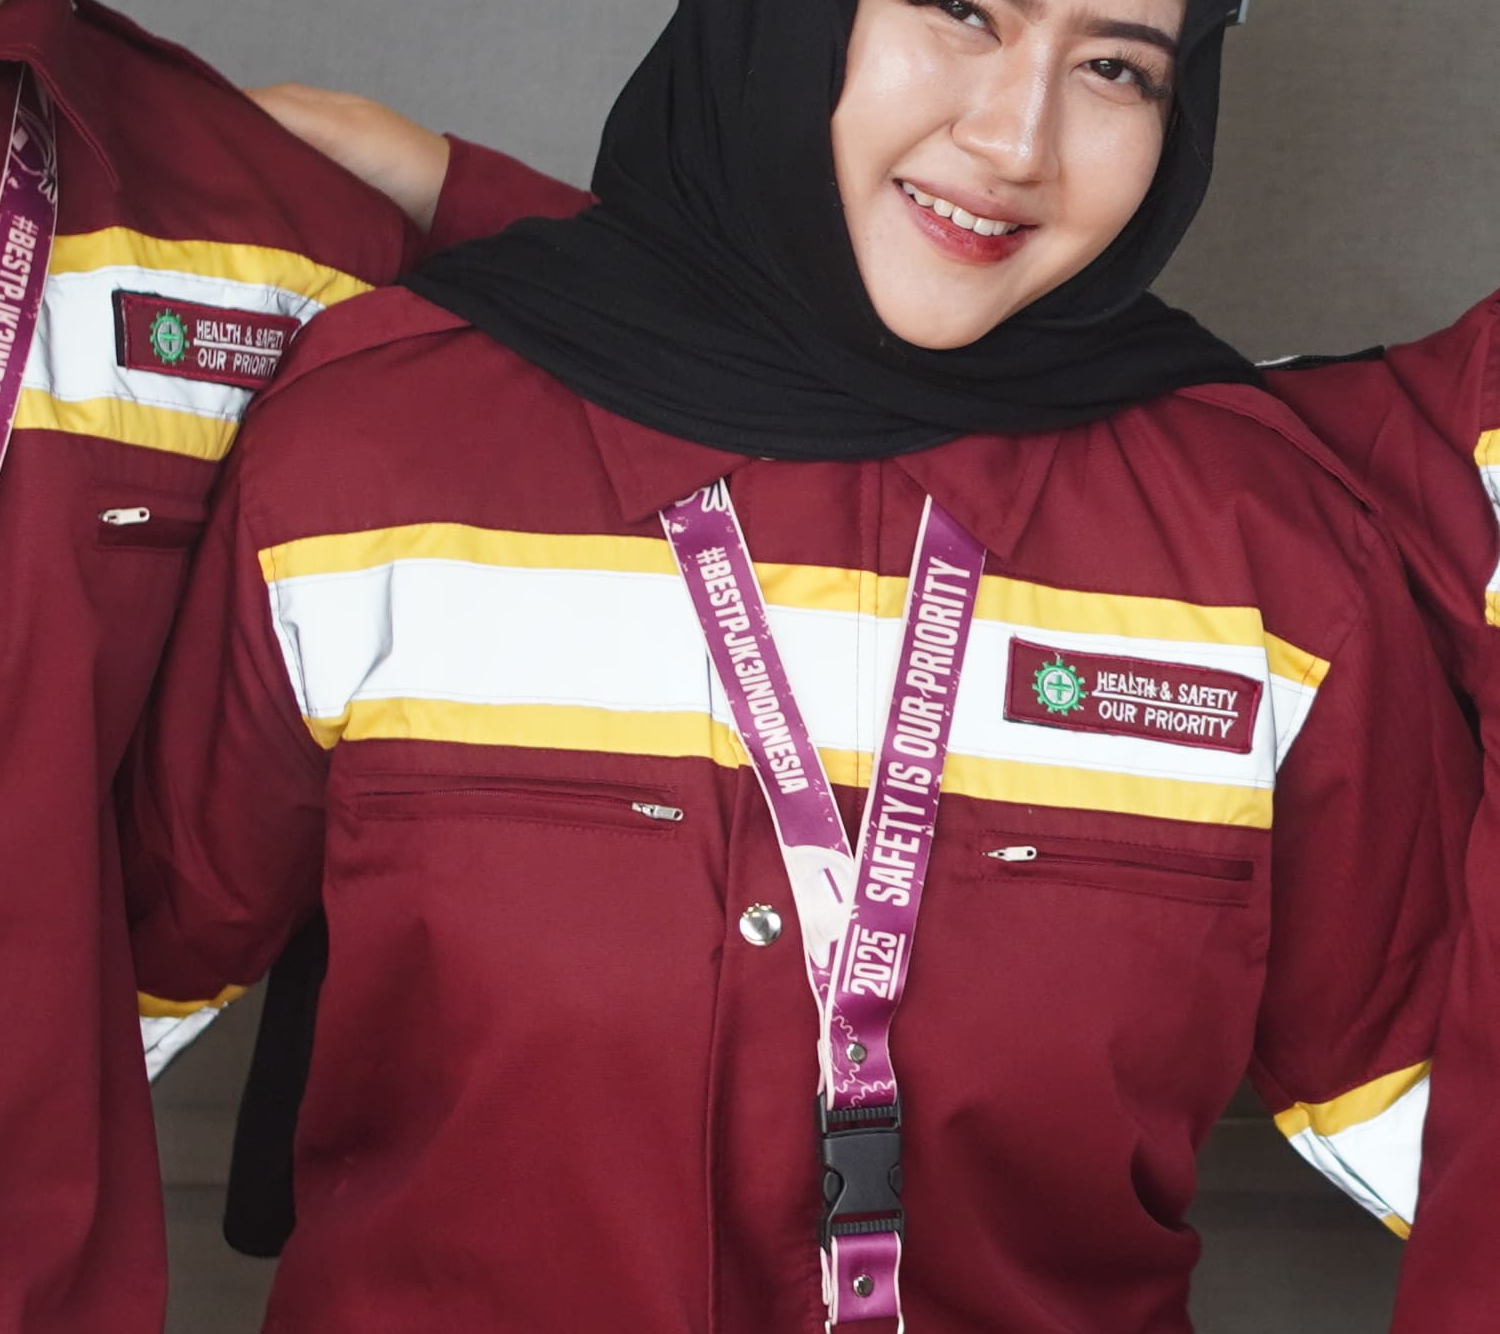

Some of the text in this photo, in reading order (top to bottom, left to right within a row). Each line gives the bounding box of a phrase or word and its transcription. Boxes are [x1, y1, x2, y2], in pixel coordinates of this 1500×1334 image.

[196, 319, 285, 350] HEALTH & SAFETY
[198, 348, 277, 377] OUR PRIORITY
[696, 547, 810, 795] #BESTPJK3INDONESIA
[1096, 670, 1238, 711] HEALTH & SAFETY
[865, 557, 971, 908] SAFETY IS OUR PRIORITY
[1098, 701, 1235, 739] OUR PRIORITY
[851, 931, 898, 998] 2025
